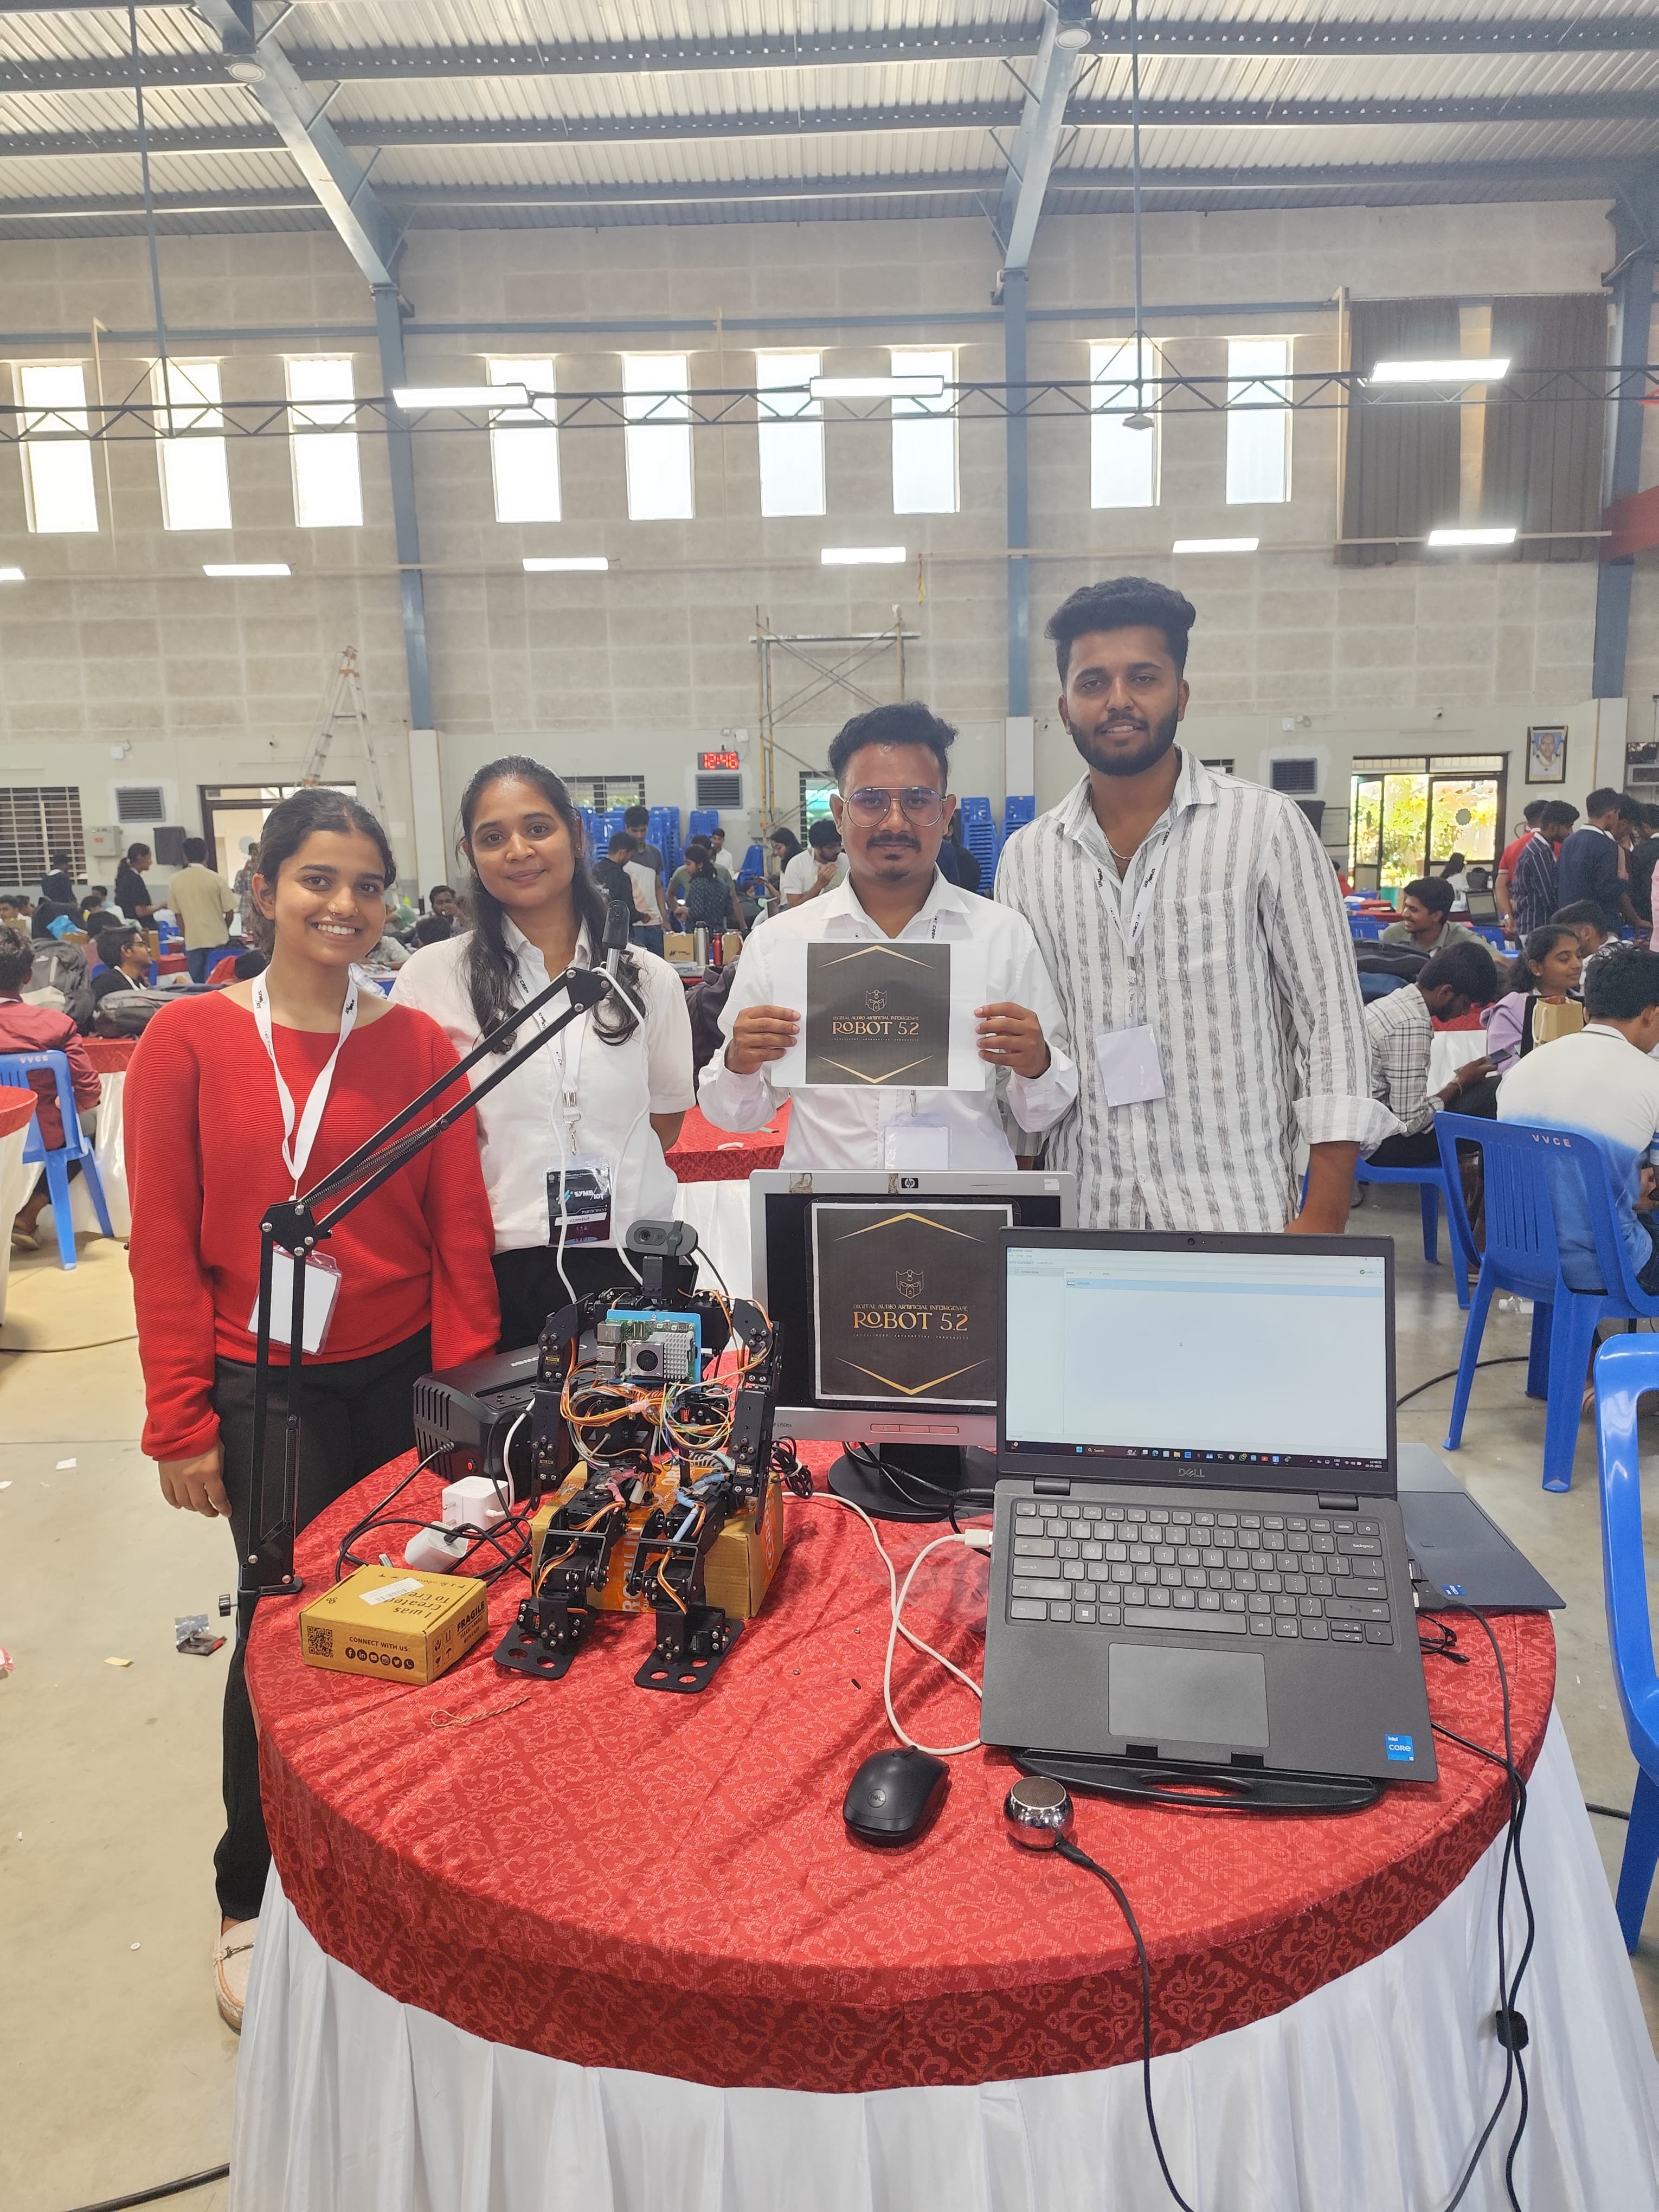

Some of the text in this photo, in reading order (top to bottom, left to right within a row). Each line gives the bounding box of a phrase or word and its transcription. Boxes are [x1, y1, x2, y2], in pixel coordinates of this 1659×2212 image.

[704, 751, 738, 769] 12:46
[832, 1021, 919, 1035] ROBOT 5.2
[1532, 1134, 1571, 1148] VVCE
[853, 1311, 969, 1331] ROBOT 5.2
[1178, 1468, 1205, 1477] DELL
[435, 1596, 451, 1604] To
[393, 1607, 423, 1616] was
[457, 1600, 485, 1632] FRAGILE
[349, 1636, 379, 1646] CONNECT
[381, 1642, 397, 1650] WITH
